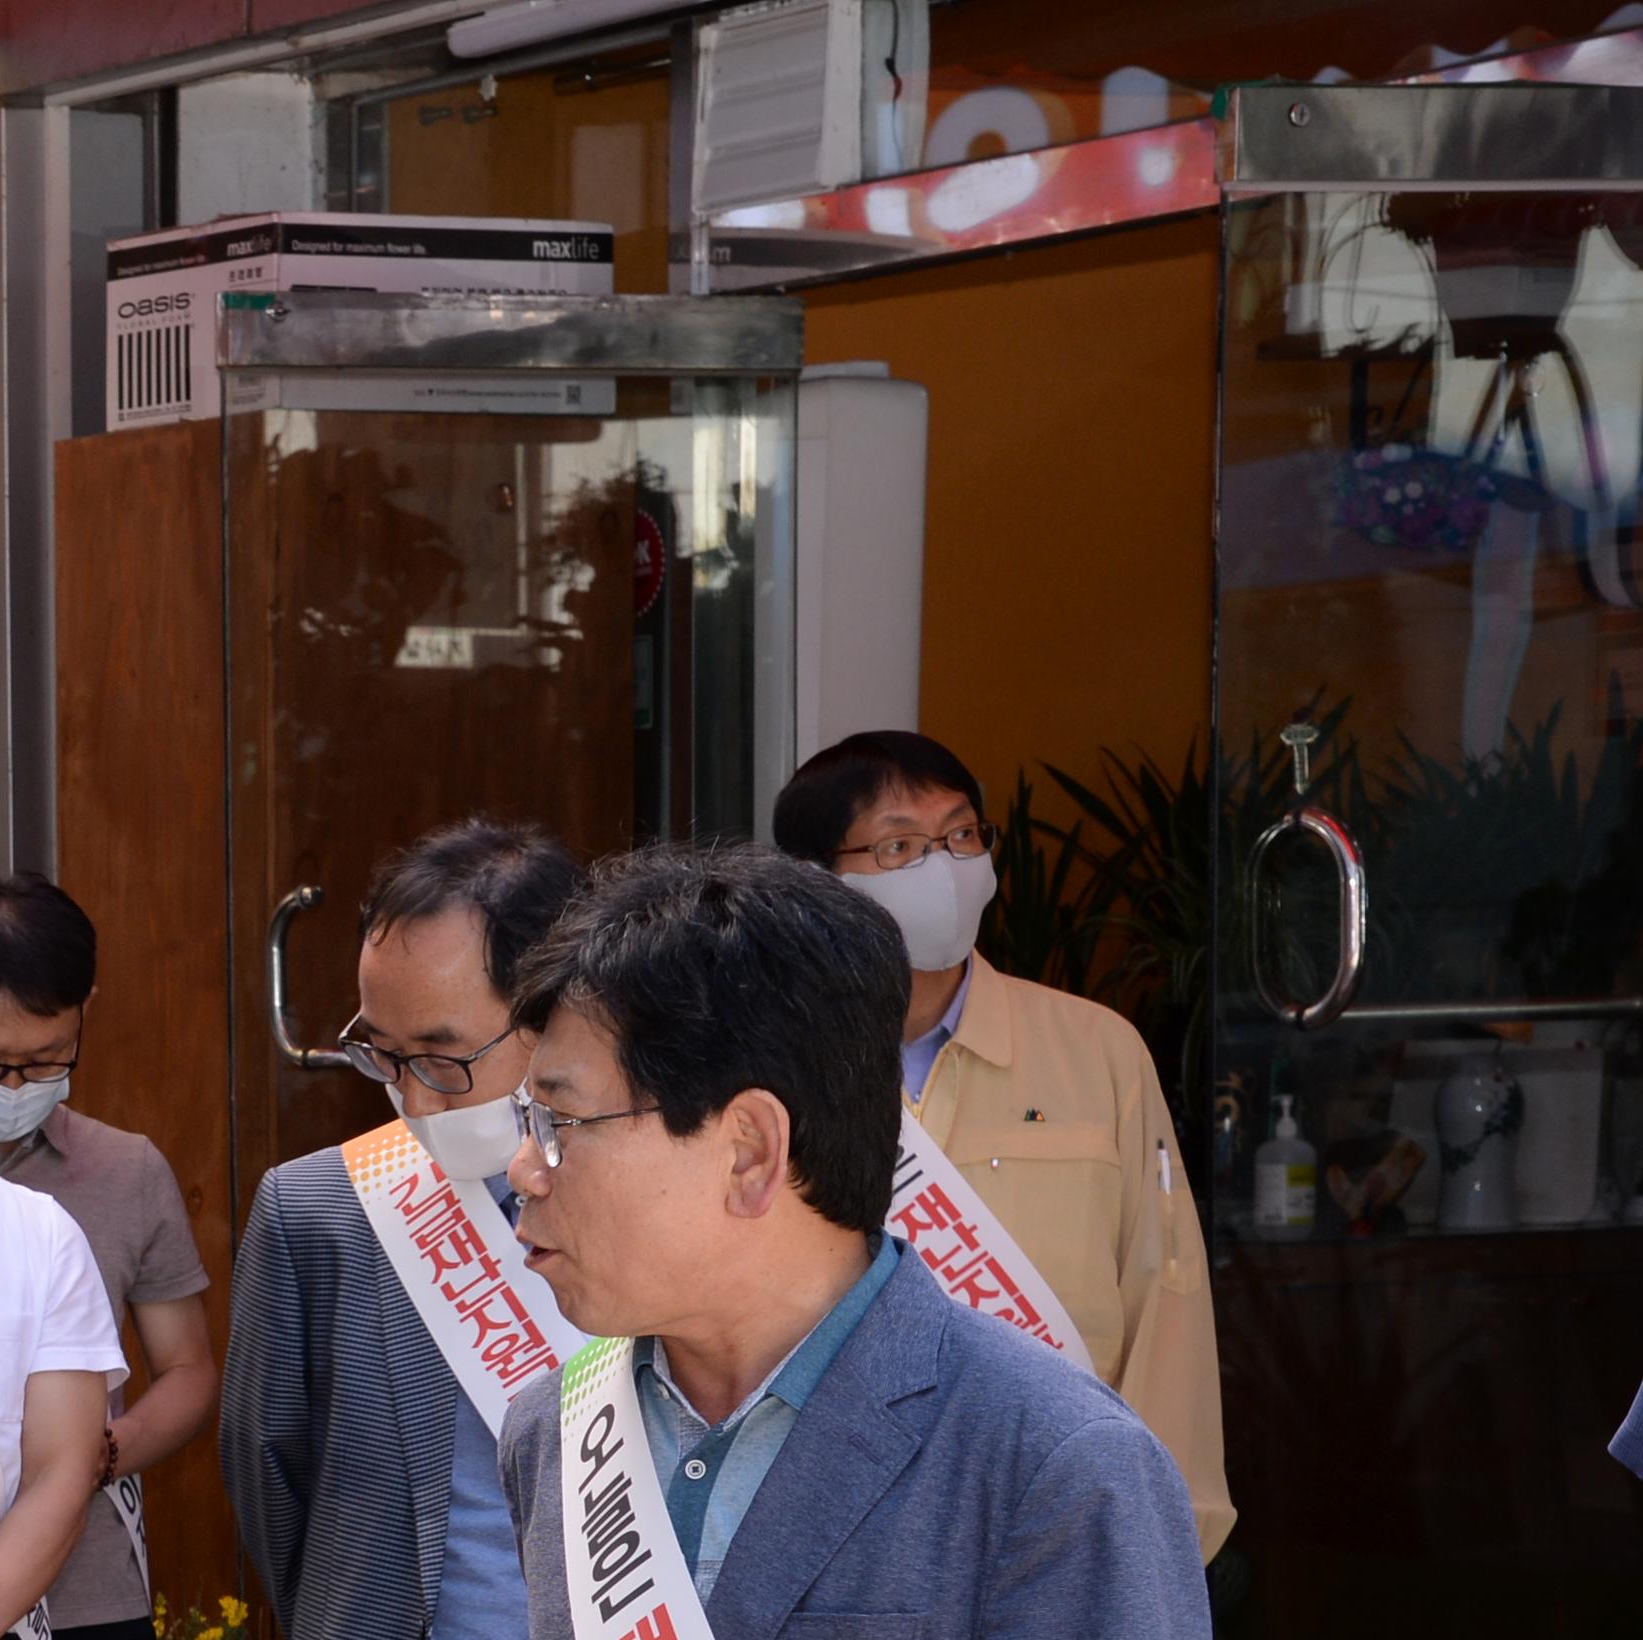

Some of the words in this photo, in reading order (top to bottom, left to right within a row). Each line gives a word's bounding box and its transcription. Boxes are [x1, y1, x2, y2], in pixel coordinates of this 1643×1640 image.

[532, 236, 600, 260] maxlife
[890, 1181, 1064, 1350] 재난지
[576, 1404, 654, 1625] 오늘은
